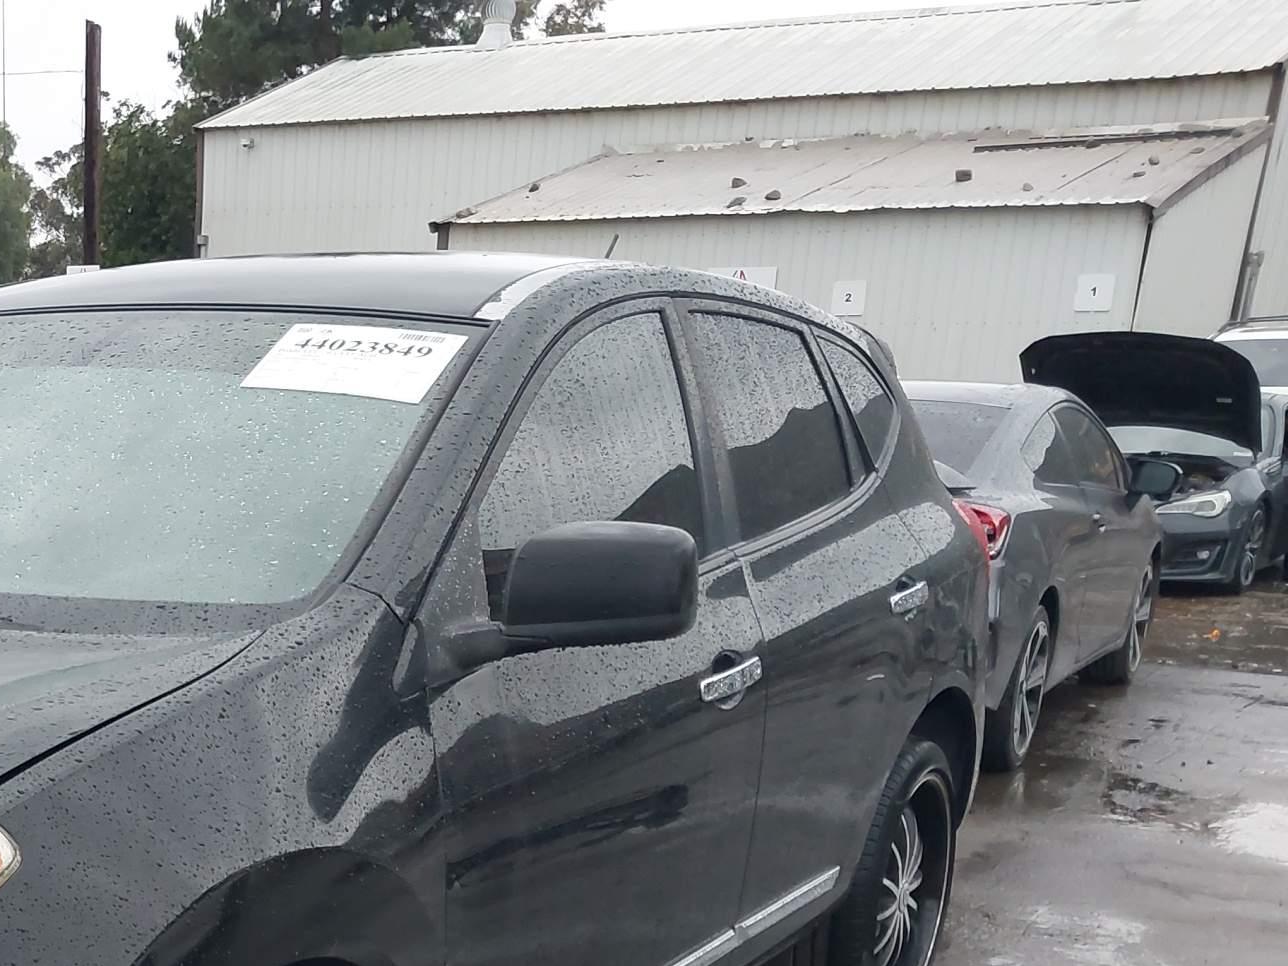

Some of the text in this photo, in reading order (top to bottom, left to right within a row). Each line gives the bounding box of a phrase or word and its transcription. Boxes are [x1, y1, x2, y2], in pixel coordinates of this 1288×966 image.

[1090, 286, 1097, 297] 1
[844, 293, 852, 303] 2
[295, 337, 433, 358] 44023849
